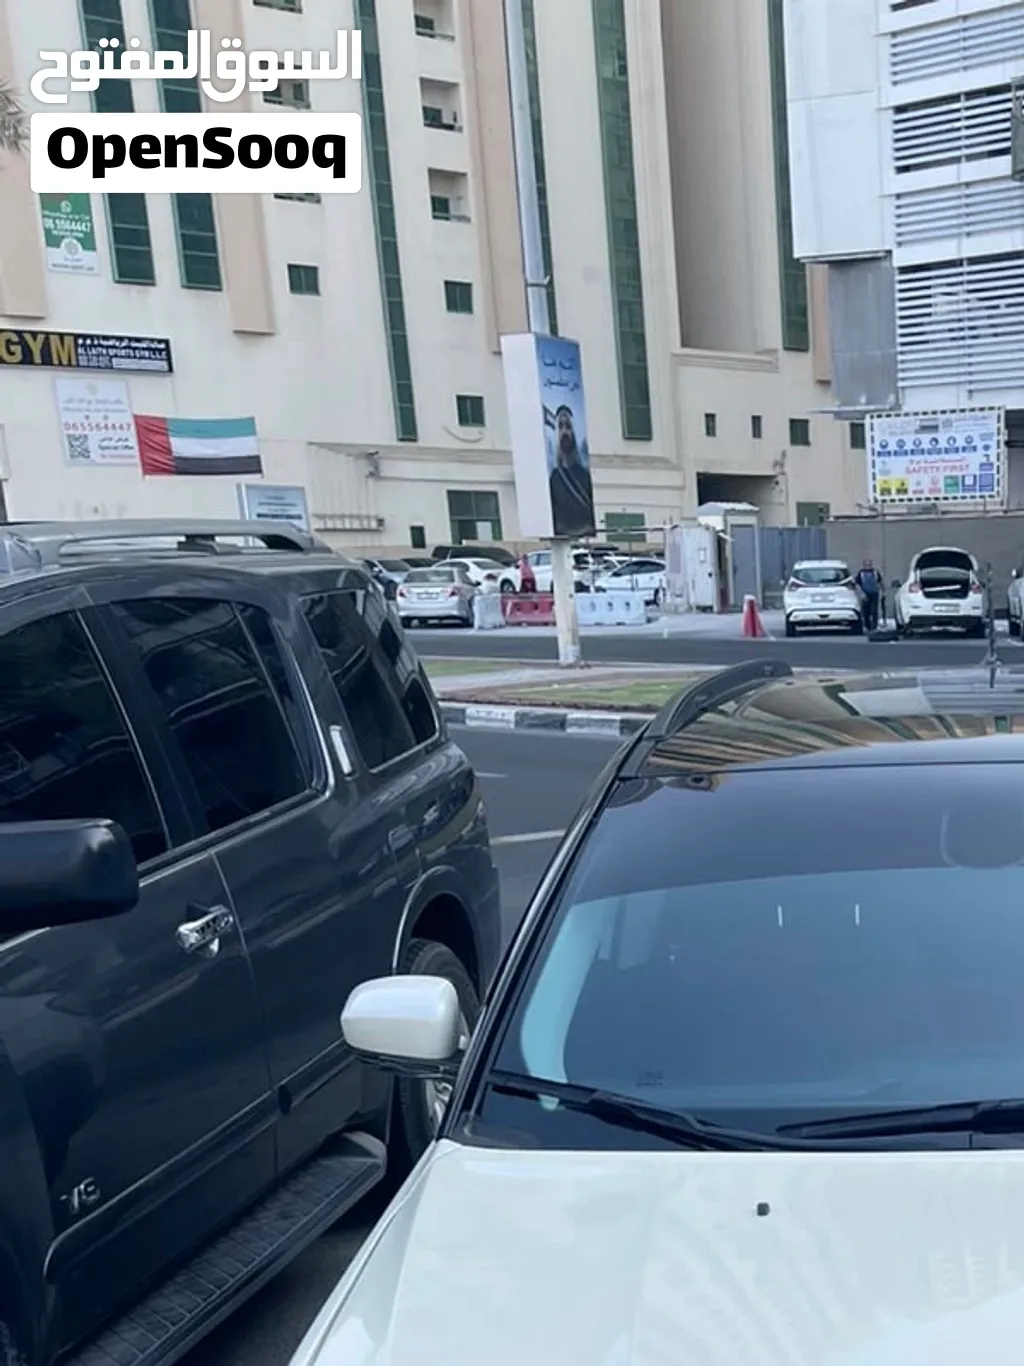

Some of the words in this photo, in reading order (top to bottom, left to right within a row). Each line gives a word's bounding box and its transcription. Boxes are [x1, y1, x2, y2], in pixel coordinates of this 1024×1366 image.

[0, 331, 76, 365] GYM
[905, 464, 941, 475] SAFETY
[943, 463, 970, 473] FIRST
